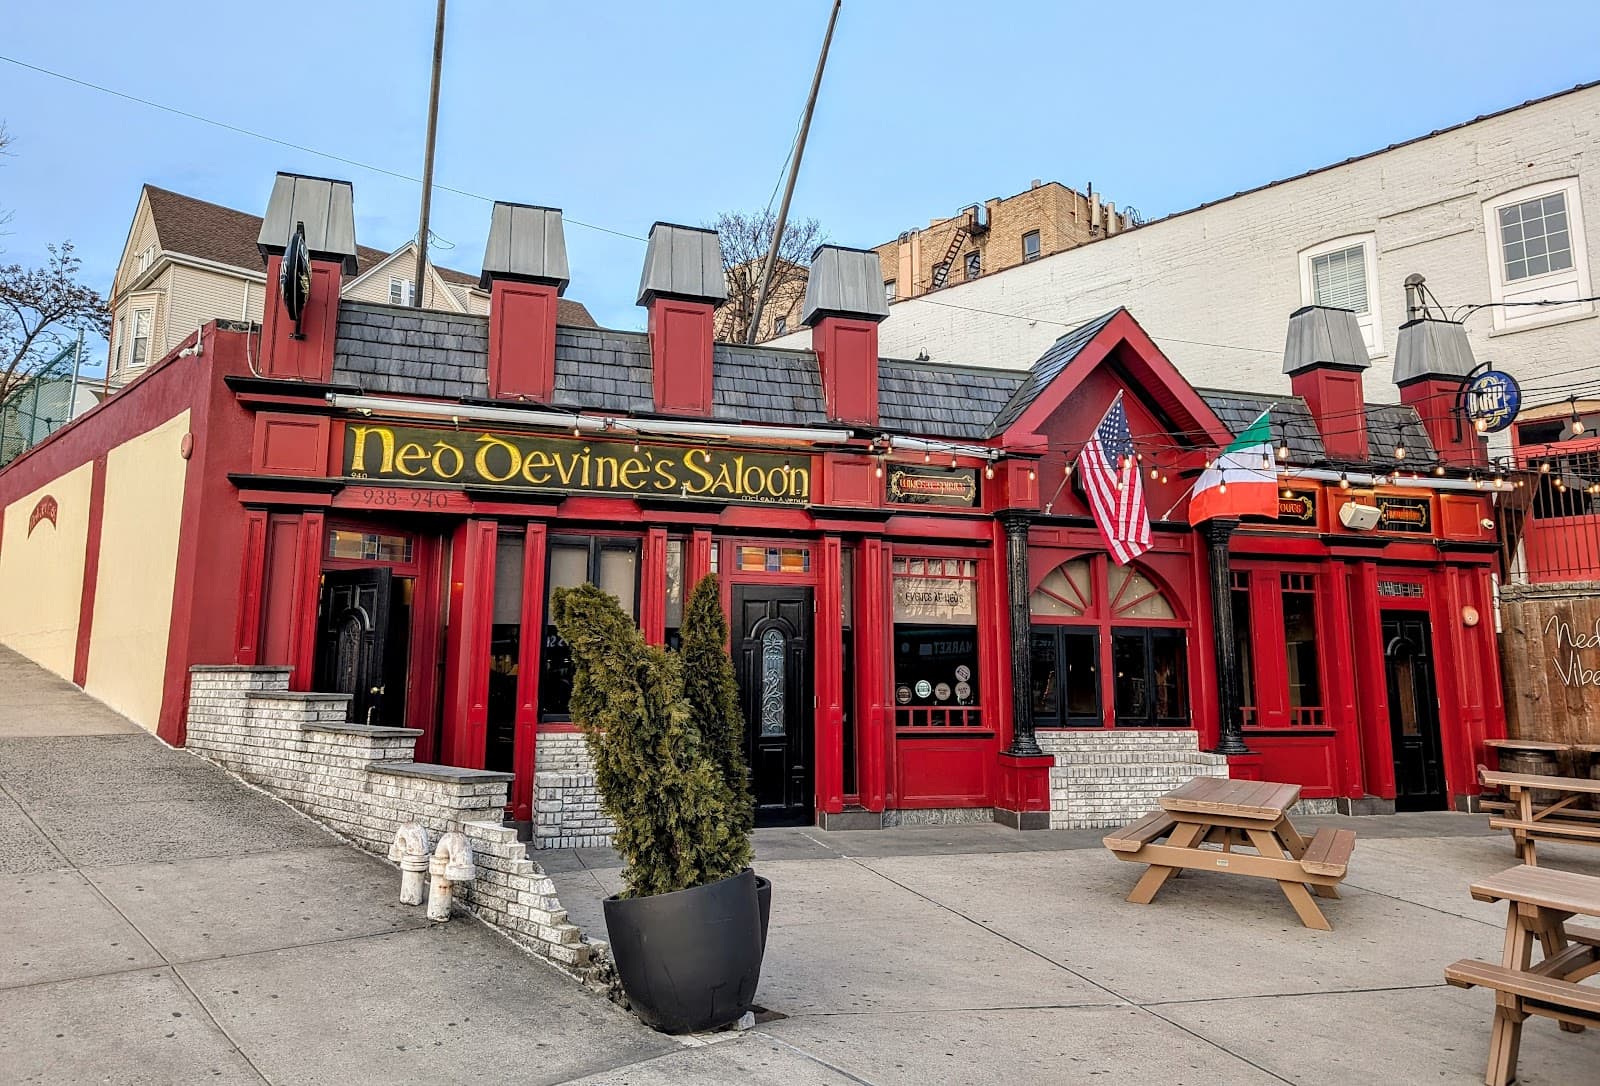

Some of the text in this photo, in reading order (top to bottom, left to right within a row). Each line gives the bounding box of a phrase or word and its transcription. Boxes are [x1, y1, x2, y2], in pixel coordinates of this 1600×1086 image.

[350, 426, 809, 497] Ned Devine's Saloon
